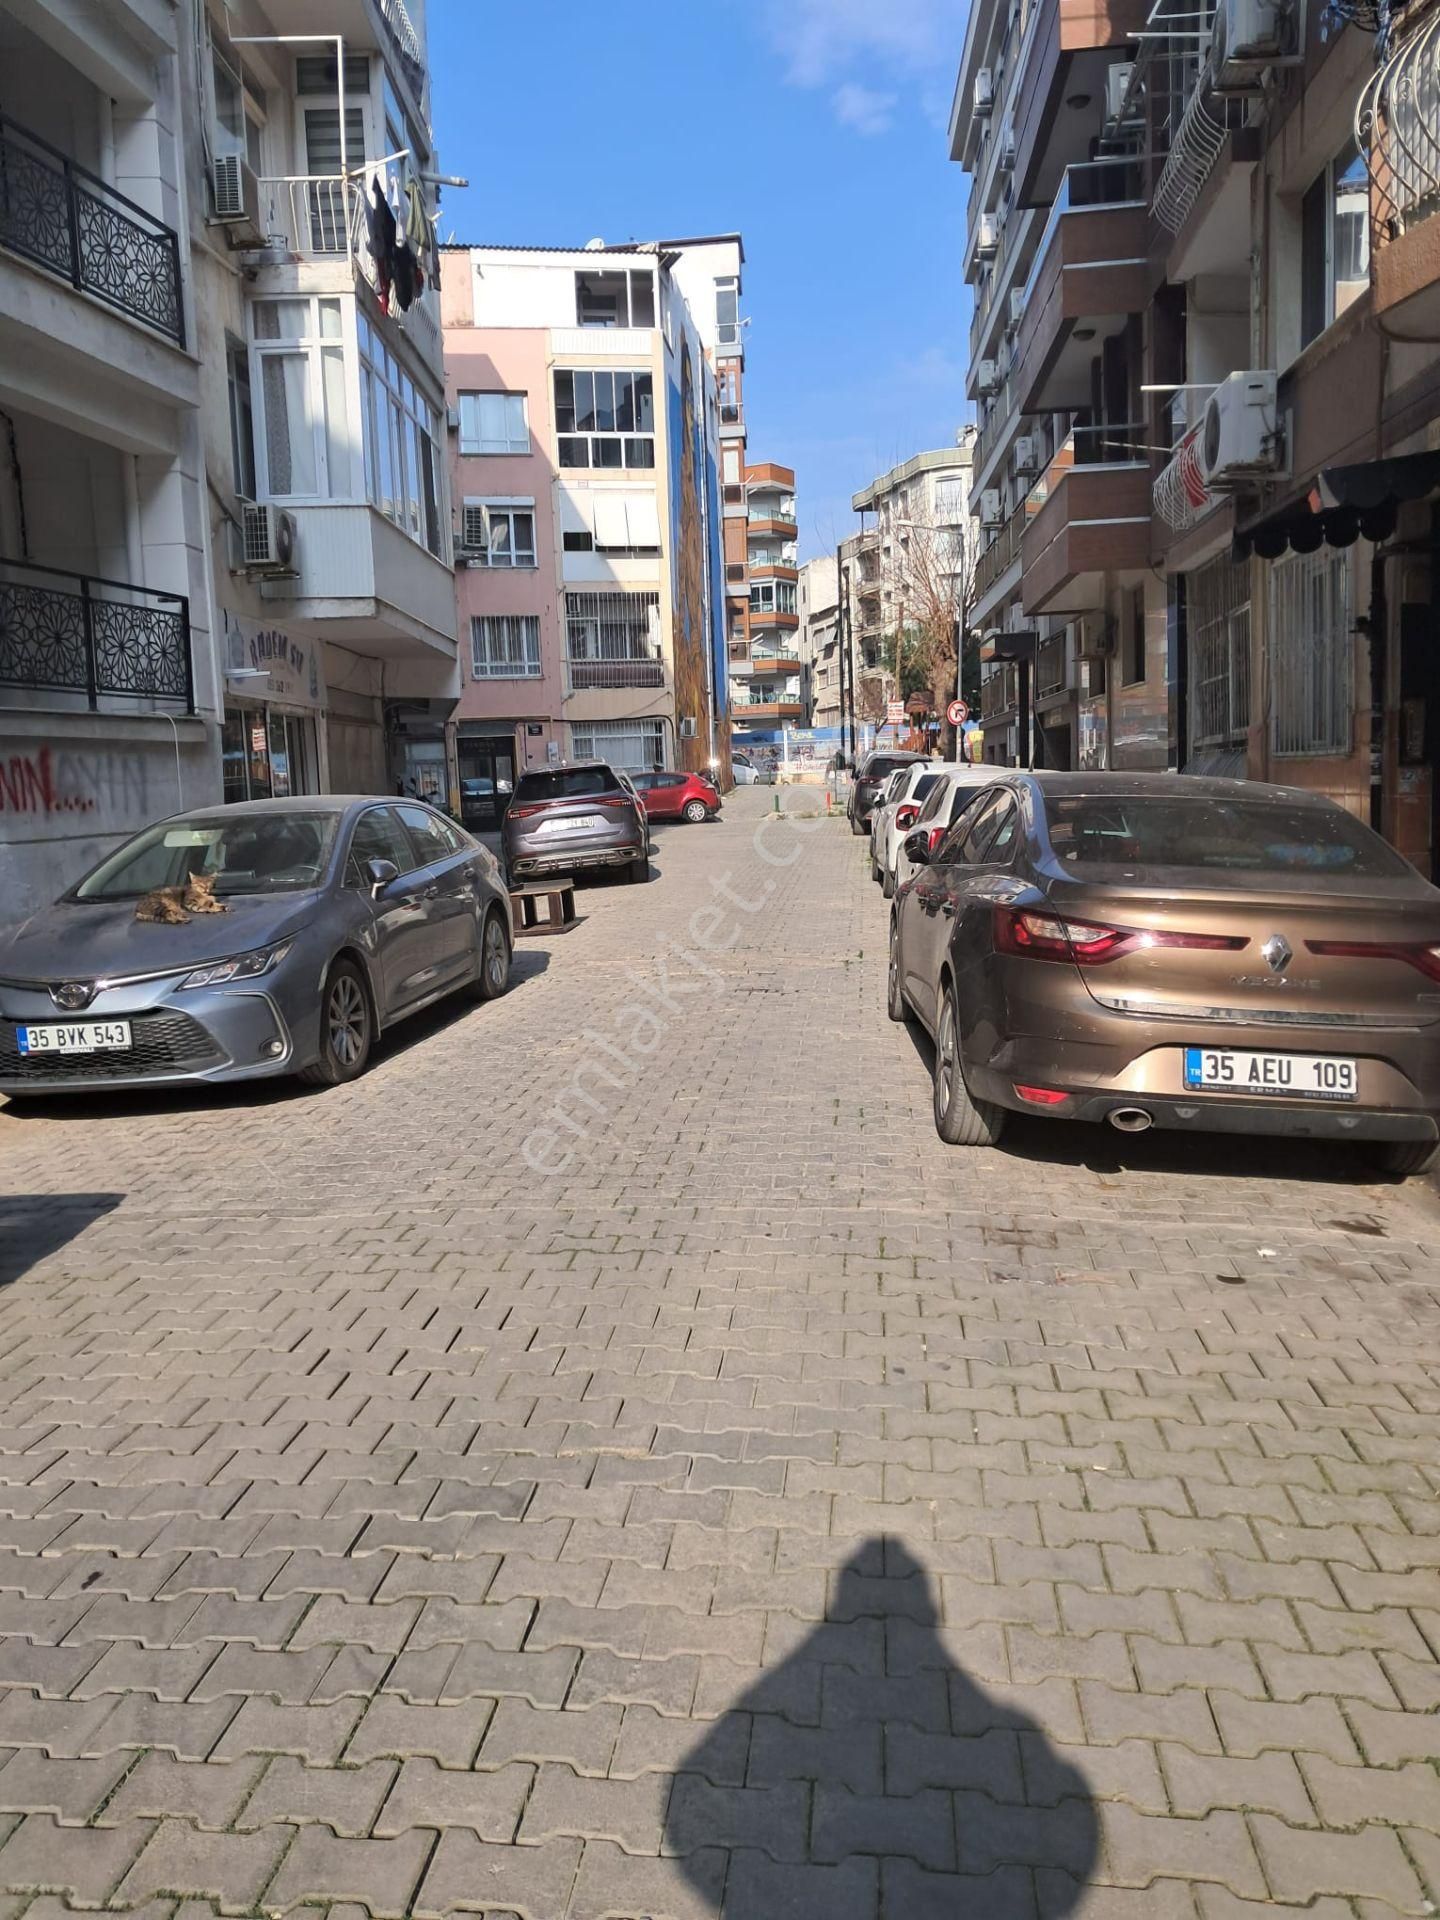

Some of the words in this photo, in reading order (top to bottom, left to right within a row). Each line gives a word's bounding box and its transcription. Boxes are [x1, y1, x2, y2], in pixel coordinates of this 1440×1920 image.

[28, 1029, 49, 1049] 35
[56, 1027, 88, 1047] BVK
[93, 1024, 125, 1045] 543
[1205, 1054, 1234, 1081] 35
[1248, 1057, 1292, 1085] AEU
[1313, 1061, 1351, 1090] 109
